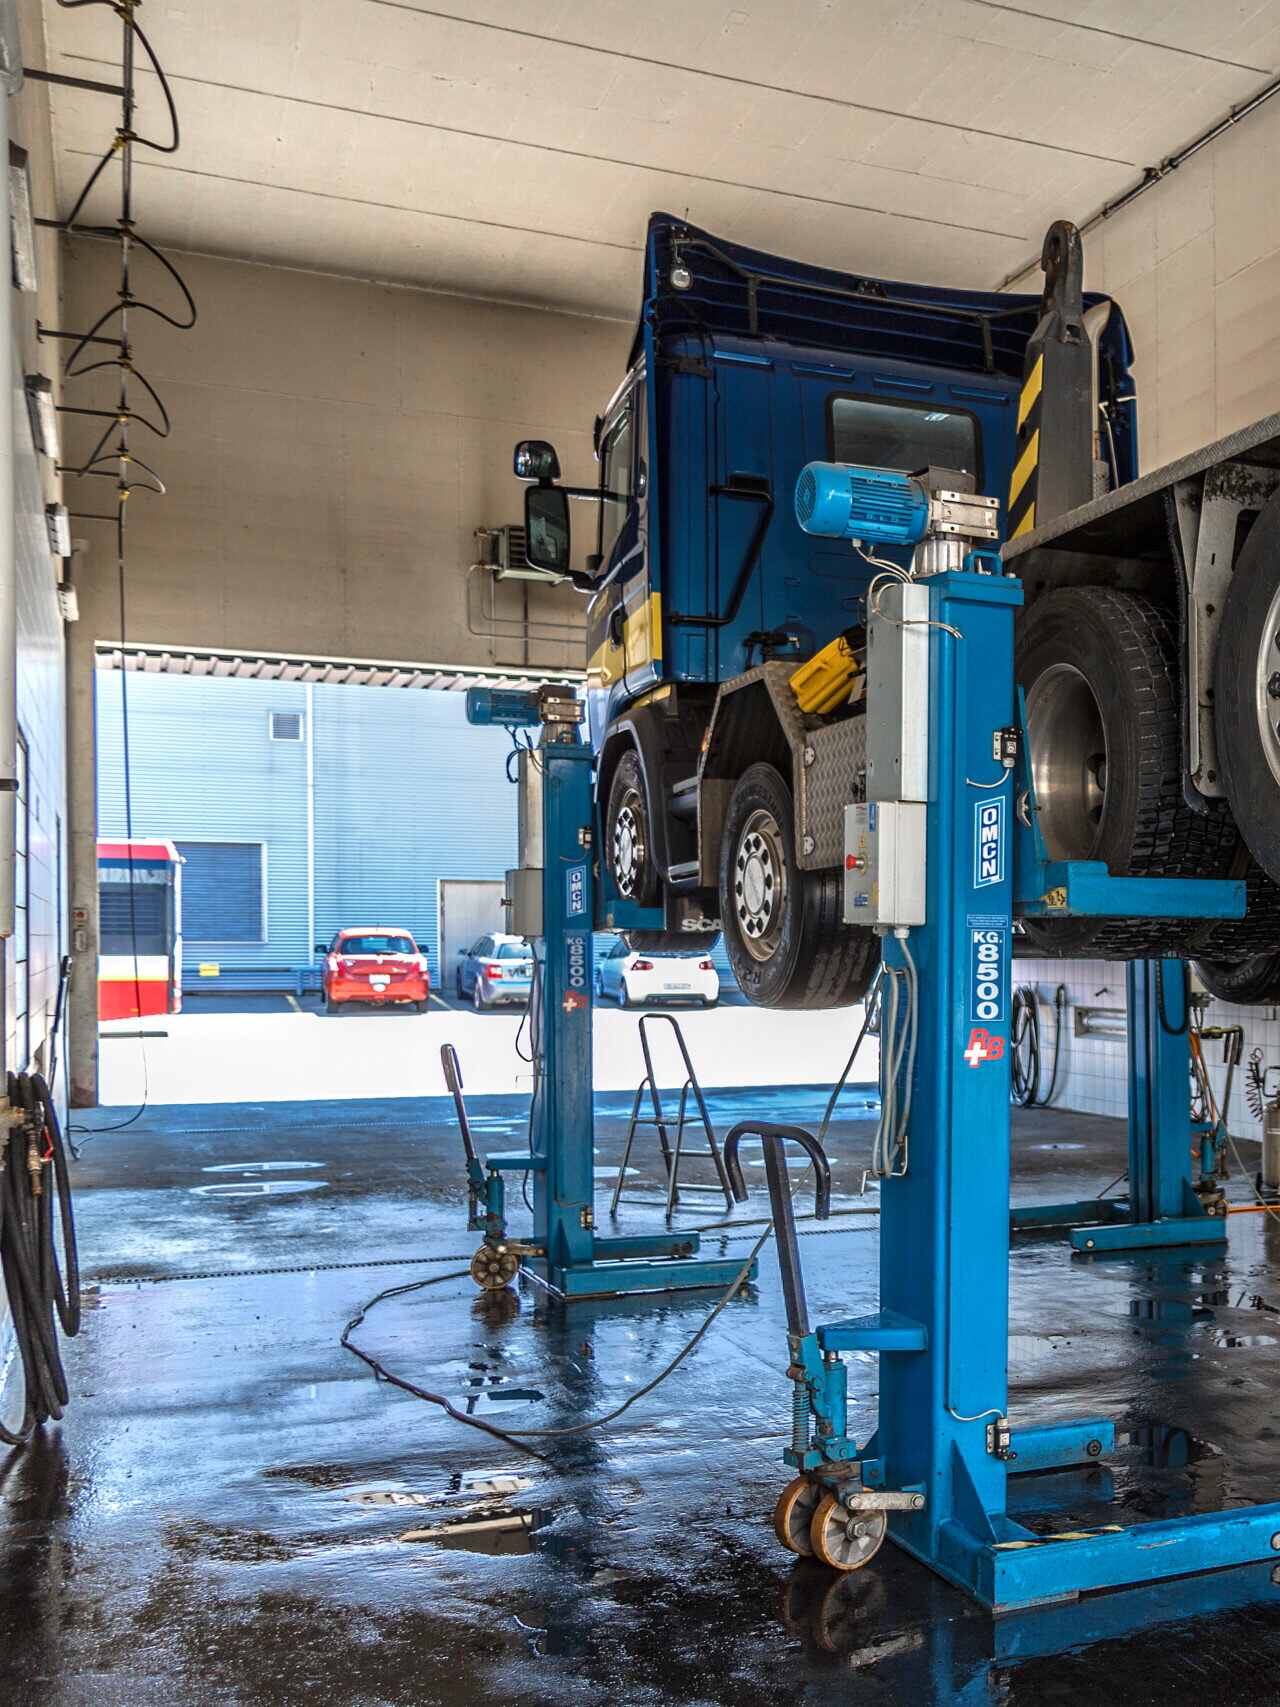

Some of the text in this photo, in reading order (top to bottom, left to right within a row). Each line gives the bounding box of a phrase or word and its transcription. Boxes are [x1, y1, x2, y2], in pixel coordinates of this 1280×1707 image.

[981, 808, 998, 878] OMCN
[571, 872, 582, 911] OMCN
[681, 918, 724, 931] SCA
[973, 931, 1003, 943] KG.
[569, 944, 585, 987] 8500
[976, 944, 1000, 1019] 8500
